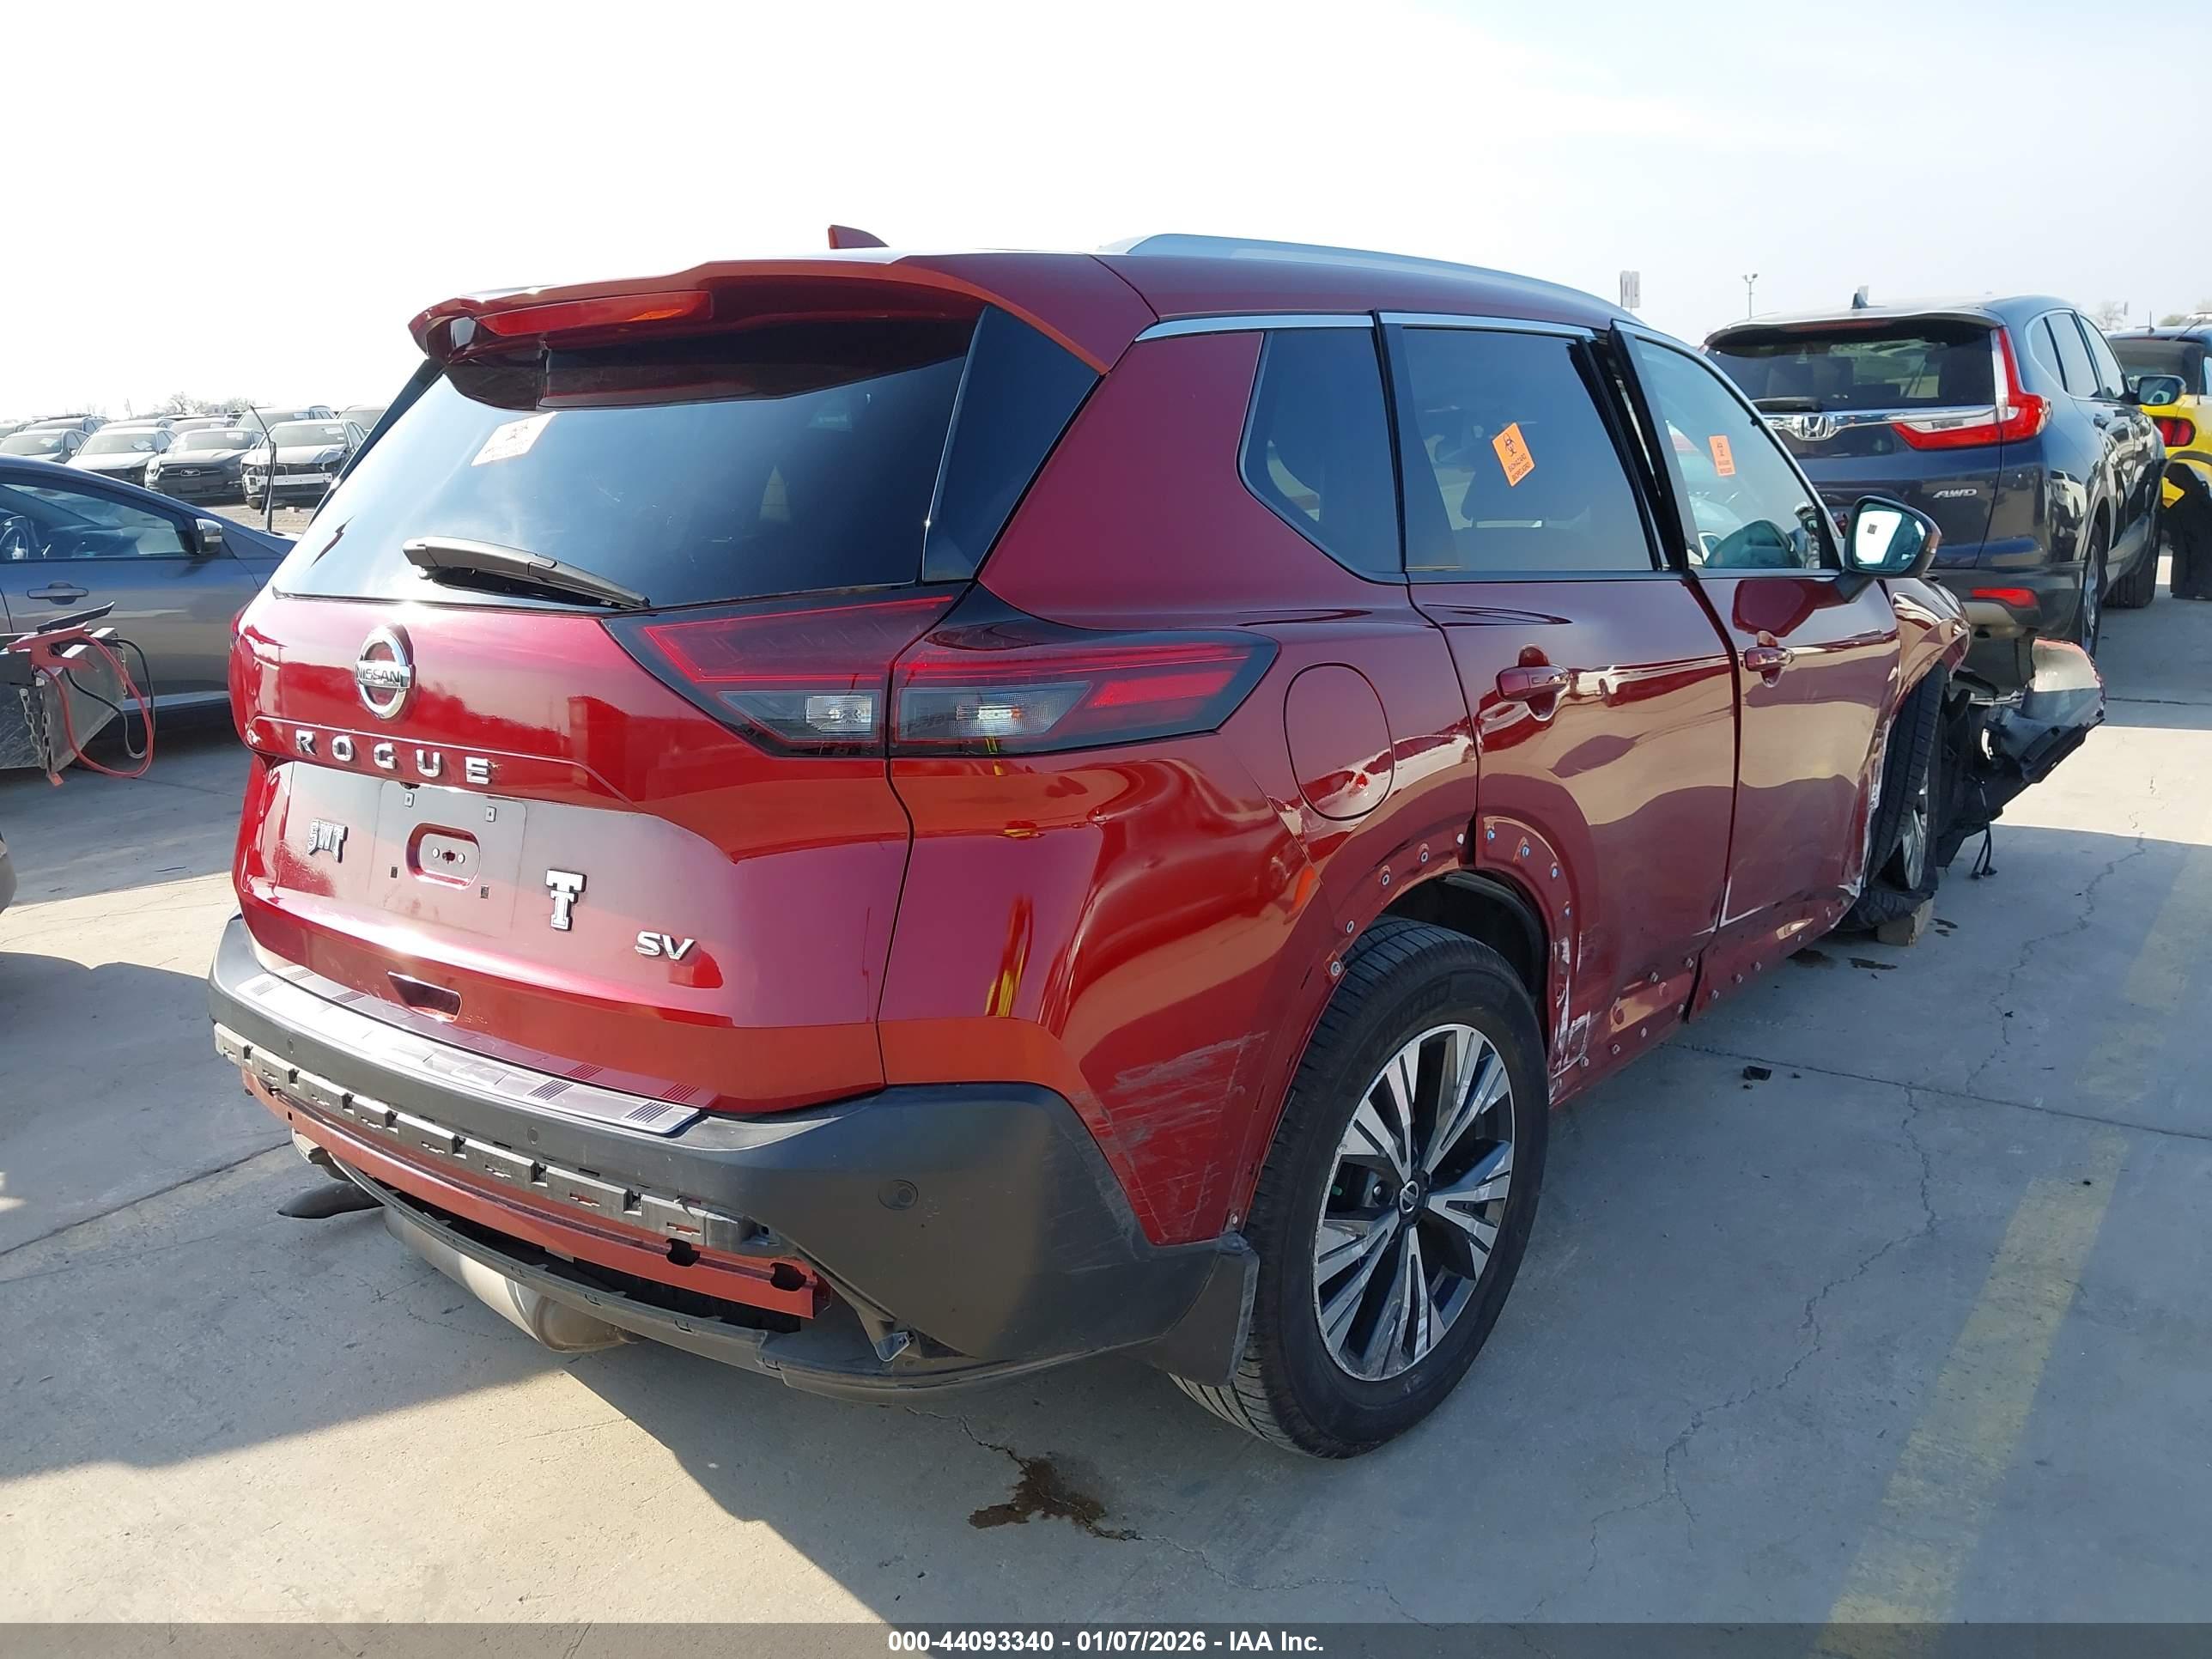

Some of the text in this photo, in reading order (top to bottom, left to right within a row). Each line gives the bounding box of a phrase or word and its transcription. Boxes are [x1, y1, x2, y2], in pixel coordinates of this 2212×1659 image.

[1932, 489, 1978, 498] AWD
[356, 665, 400, 684] NISSAN
[295, 729, 490, 785] ROGUE
[634, 931, 695, 960] SV
